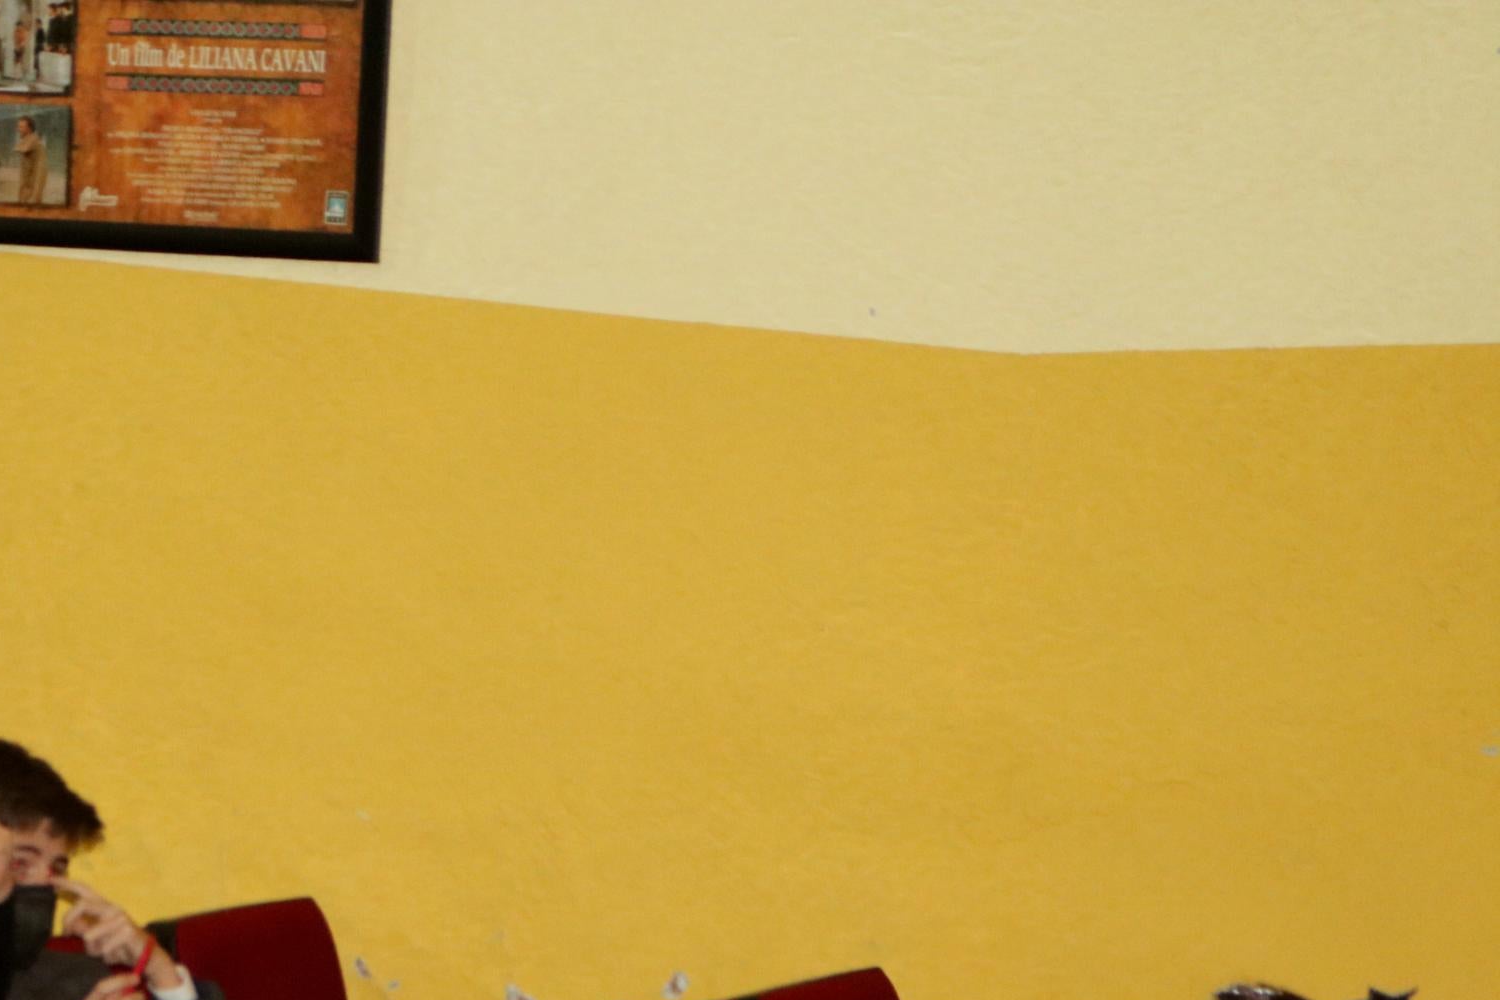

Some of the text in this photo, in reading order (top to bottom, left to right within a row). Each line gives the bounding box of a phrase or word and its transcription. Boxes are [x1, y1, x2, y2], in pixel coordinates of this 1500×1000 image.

[106, 41, 327, 73] Un film de LILIANA CAVANI
